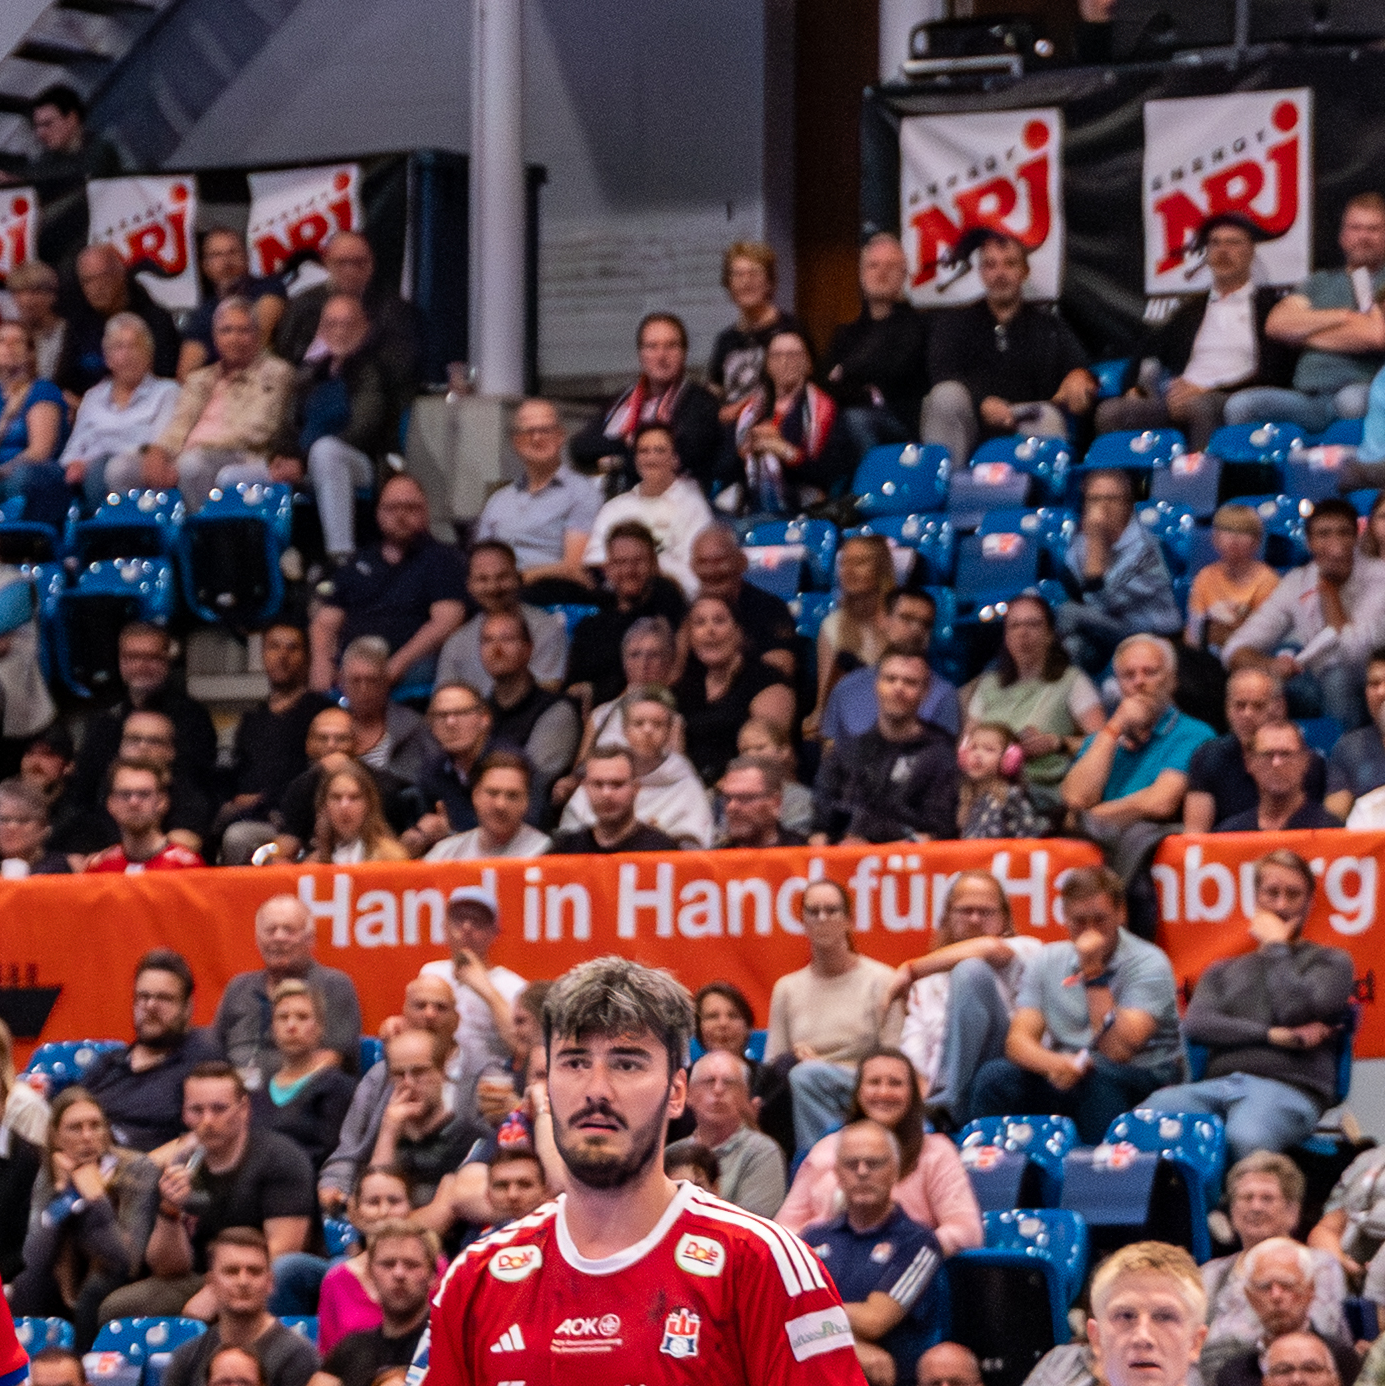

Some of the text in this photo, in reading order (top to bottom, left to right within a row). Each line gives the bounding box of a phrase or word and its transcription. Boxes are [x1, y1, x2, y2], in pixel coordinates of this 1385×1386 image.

[297, 856, 499, 948] Han
[523, 866, 593, 942] in
[554, 1317, 600, 1336] AOK
